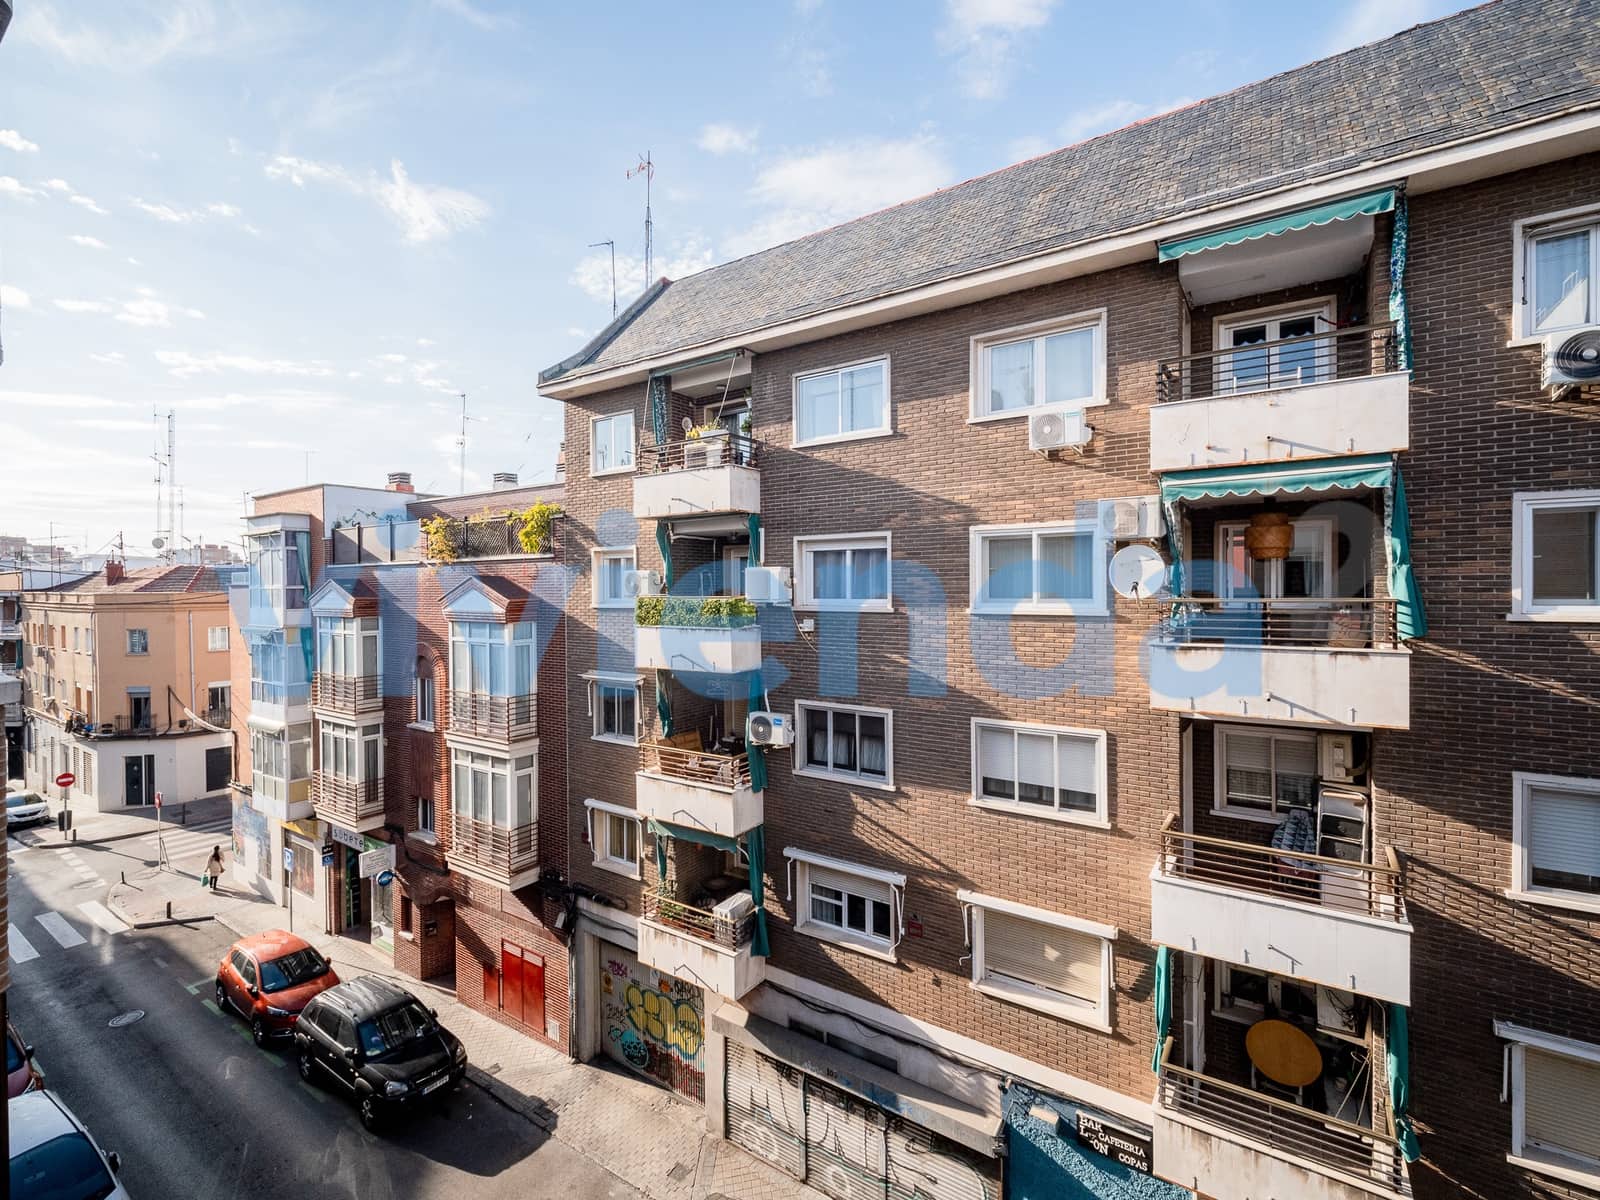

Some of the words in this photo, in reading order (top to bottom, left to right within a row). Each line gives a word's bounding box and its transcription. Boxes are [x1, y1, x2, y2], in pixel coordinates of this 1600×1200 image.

[1079, 1116, 1103, 1132] BAR
[1098, 1133, 1146, 1158] CAFETERIA
[1118, 1153, 1148, 1172] COPAS
